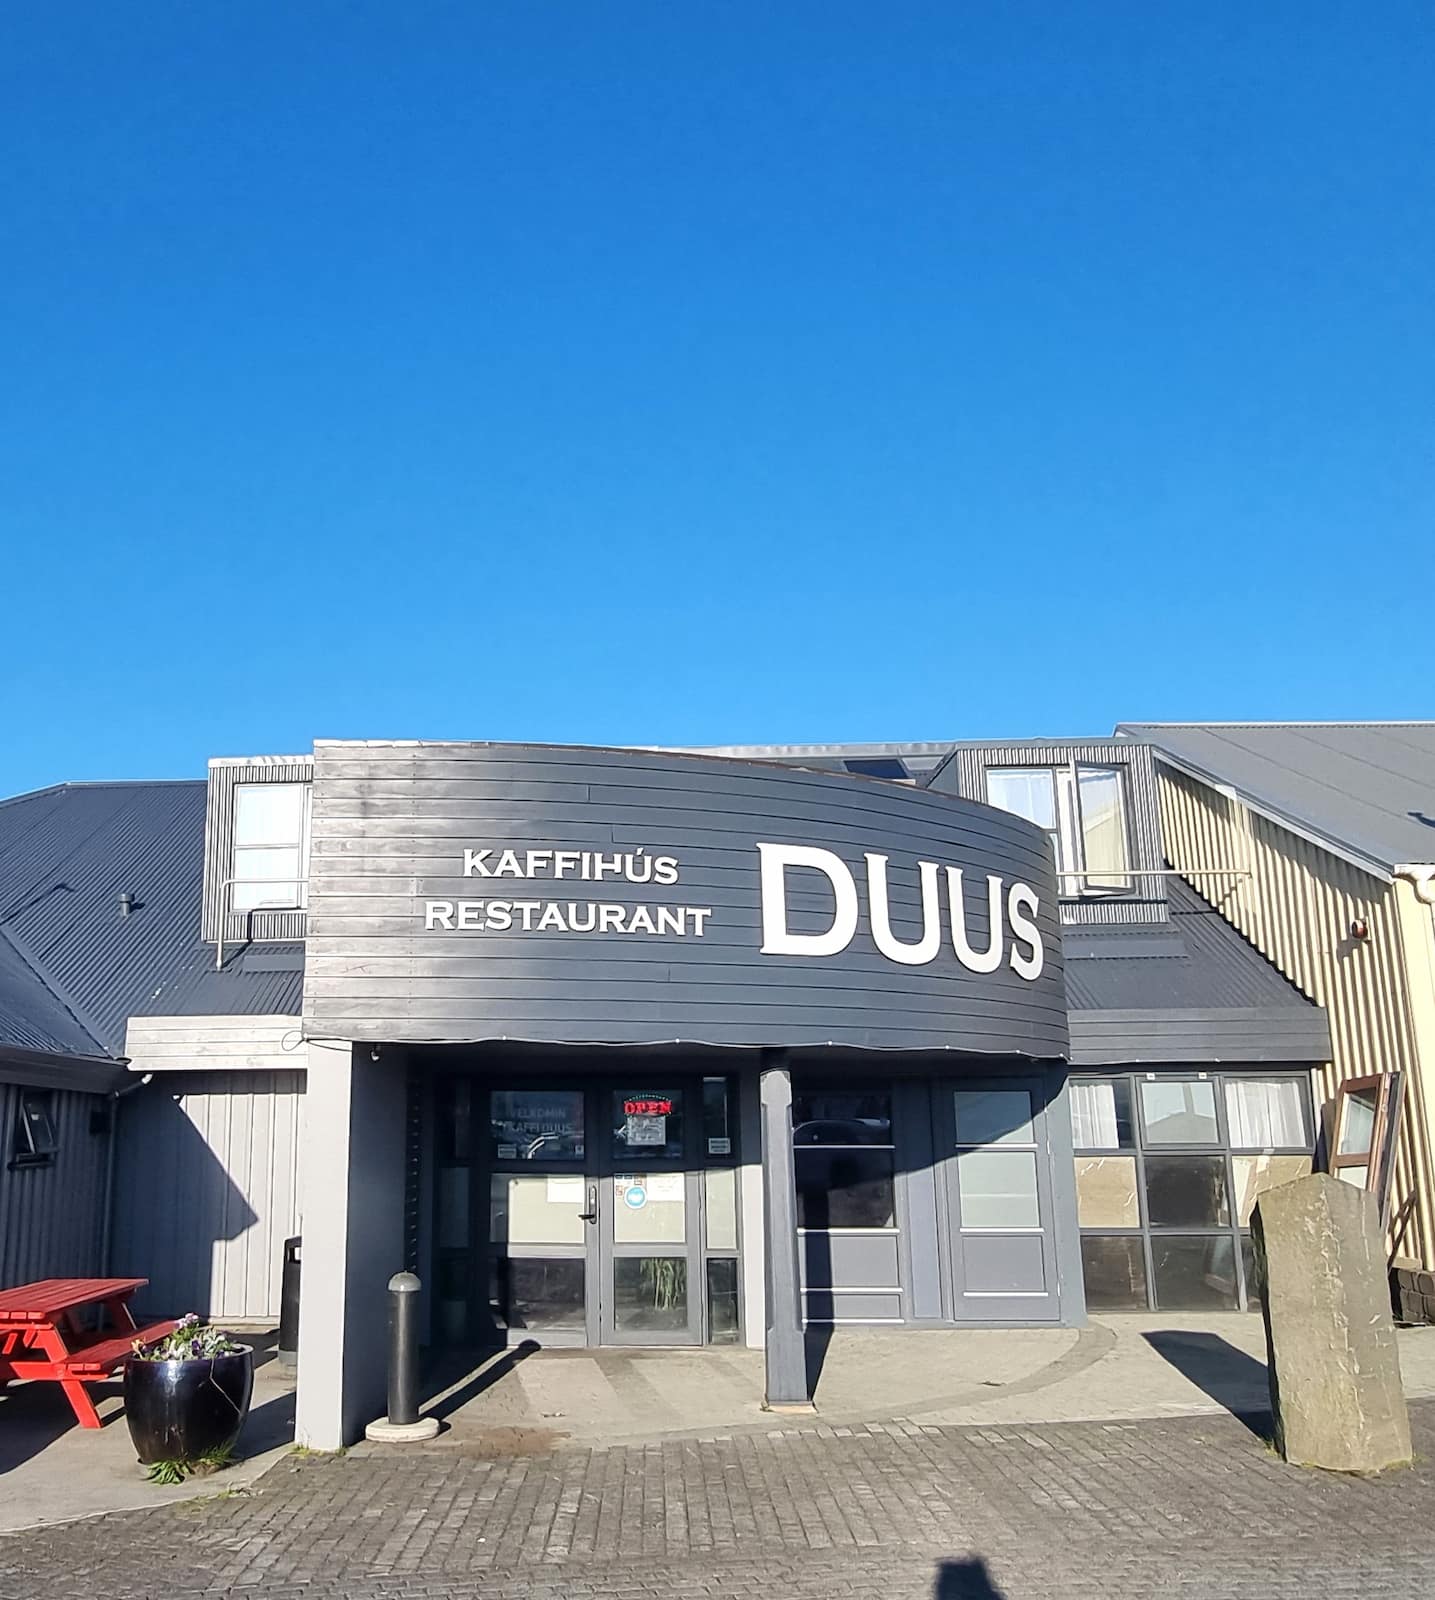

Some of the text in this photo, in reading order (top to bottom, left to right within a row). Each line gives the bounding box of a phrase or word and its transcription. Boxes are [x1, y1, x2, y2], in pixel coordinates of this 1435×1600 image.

[463, 847, 679, 885] KAFFIHÚS
[424, 900, 712, 937] RESTAURANT
[756, 842, 1044, 981] DUUS
[624, 1101, 671, 1114] OPEN
